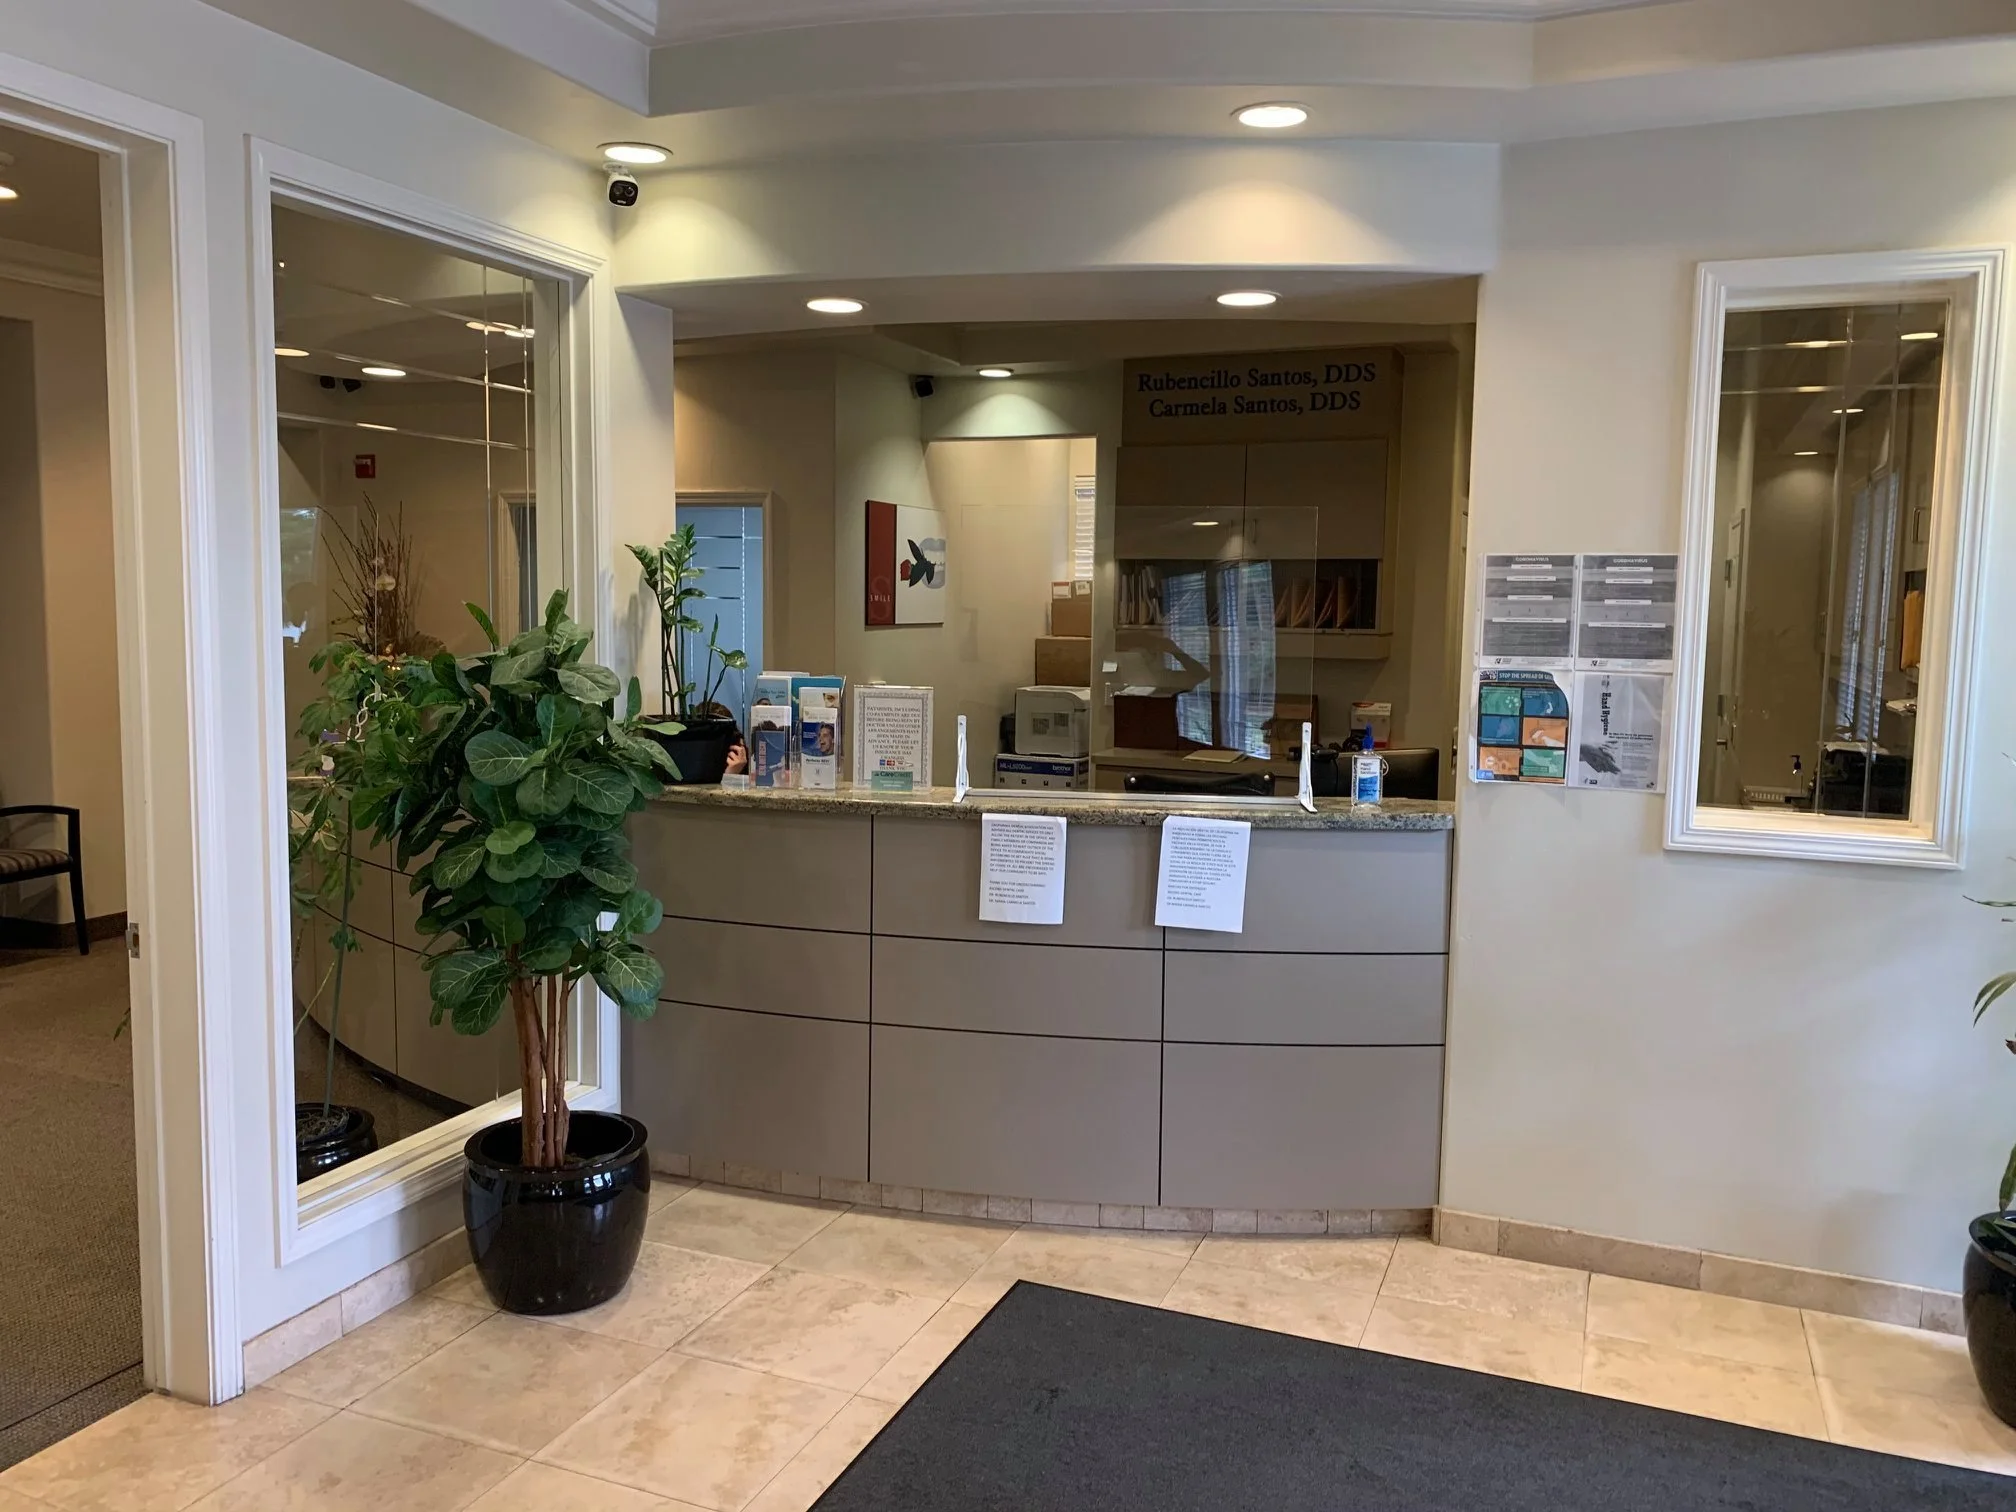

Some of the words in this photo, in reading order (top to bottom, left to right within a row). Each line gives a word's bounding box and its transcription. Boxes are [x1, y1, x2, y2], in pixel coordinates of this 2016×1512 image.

[1137, 369, 1241, 392] Rubencillo
[1247, 368, 1318, 388] Santos,
[1323, 363, 1376, 383] DDS
[1149, 396, 1227, 418] Carmela
[1233, 395, 1304, 416] Santos,
[1309, 391, 1361, 411] DDS
[870, 594, 891, 602] SMILE
[1602, 692, 1611, 709] Hand
